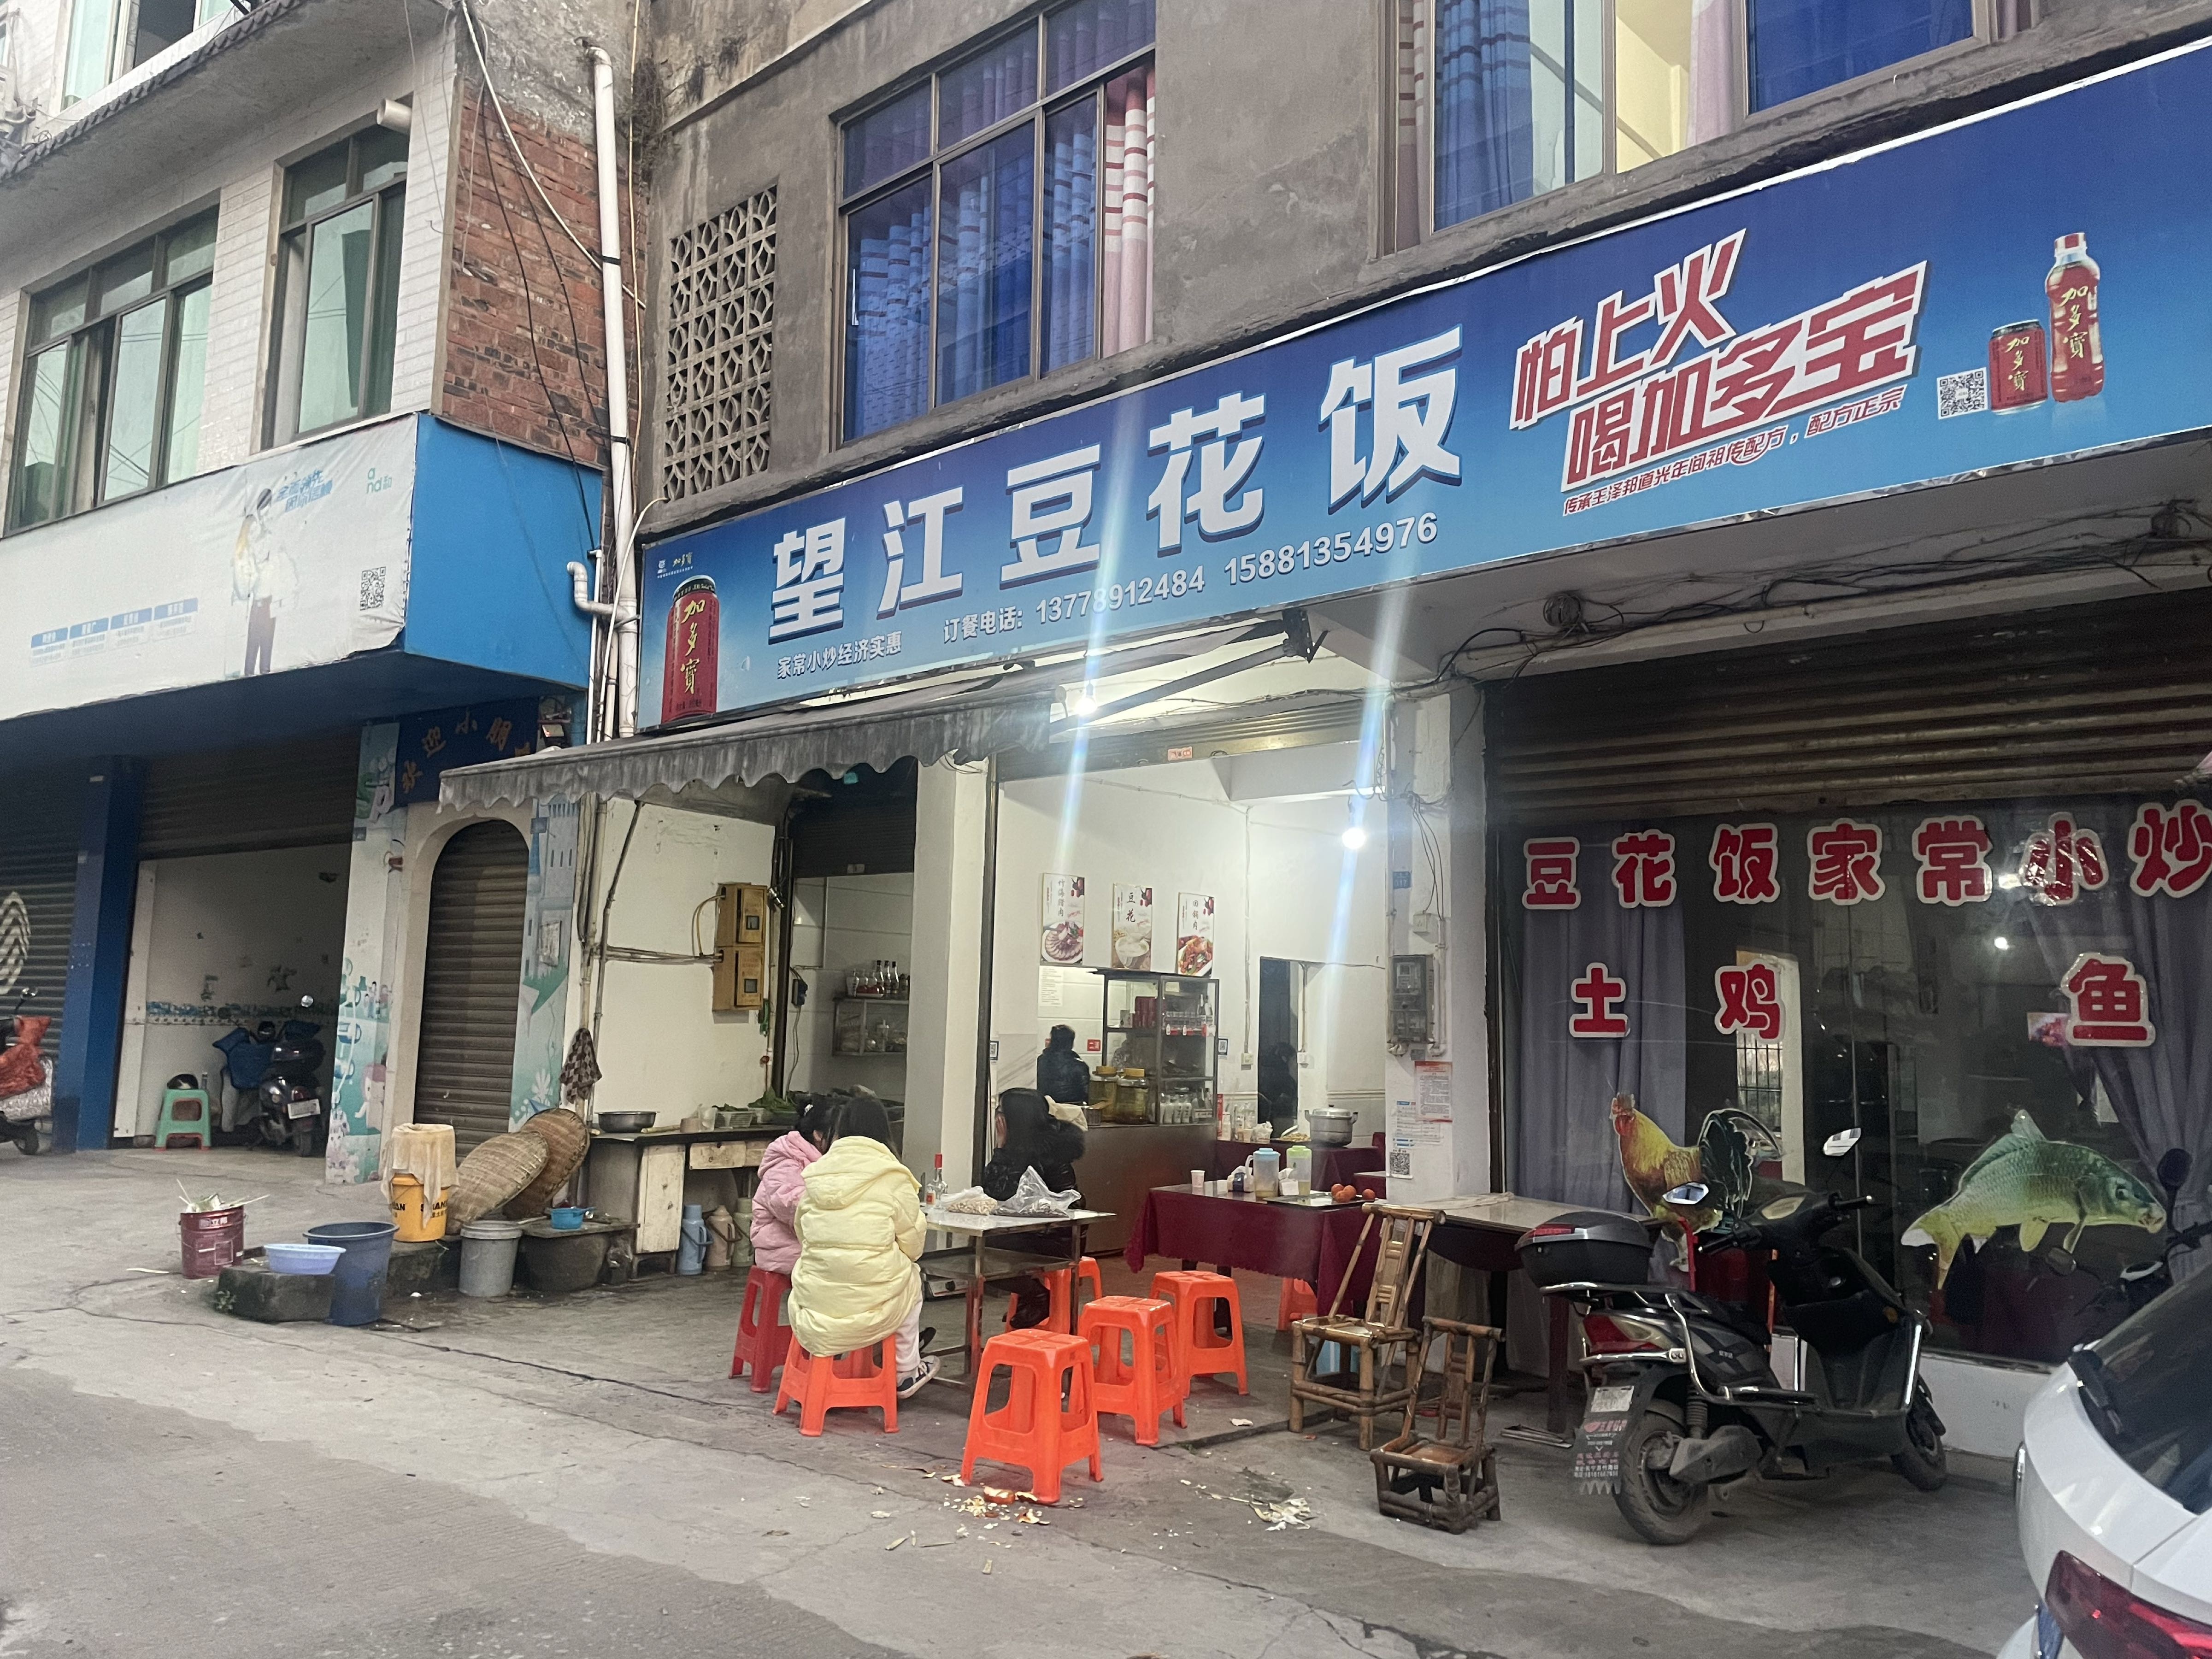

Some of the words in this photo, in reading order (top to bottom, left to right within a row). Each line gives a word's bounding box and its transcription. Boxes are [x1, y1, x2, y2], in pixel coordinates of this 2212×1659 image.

[1561, 260, 1927, 492] 喝加多宝
[769, 324, 1462, 644] 望江豆花饭
[1224, 511, 1438, 586] 15881354976
[1035, 565, 1206, 625] 13778912484
[777, 630, 902, 679] 家常小炒经济实惠
[1125, 892, 1136, 922] 豆花
[2061, 952, 2156, 1047] 鱼
